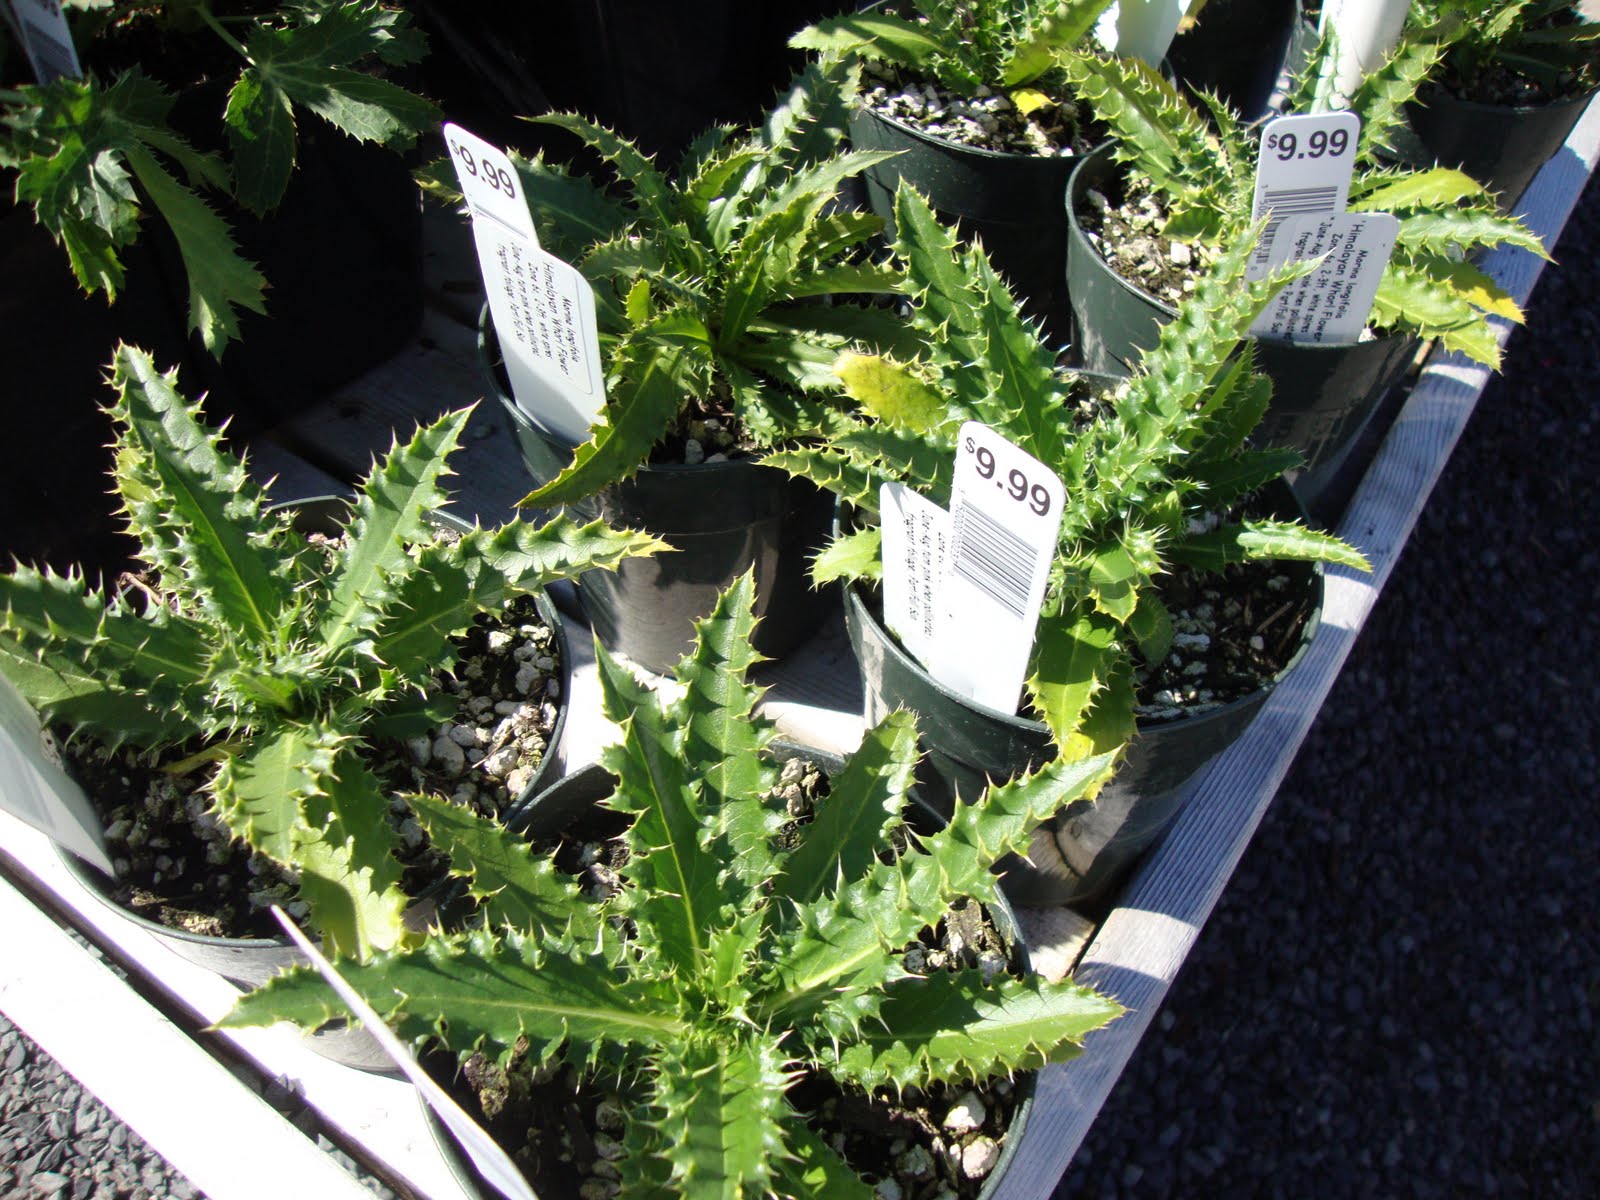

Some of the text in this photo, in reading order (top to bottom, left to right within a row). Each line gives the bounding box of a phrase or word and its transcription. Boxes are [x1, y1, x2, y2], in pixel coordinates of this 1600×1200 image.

[1267, 128, 1349, 161] $9.99
[450, 139, 516, 199] $9.99
[1325, 281, 1345, 308] Whorl
[1335, 249, 1369, 320] Morina longifolia
[1295, 291, 1307, 307] when
[1307, 295, 1320, 312] white
[552, 318, 565, 346] Whorl
[1300, 314, 1313, 333] spires
[965, 436, 1051, 517] $9.99
